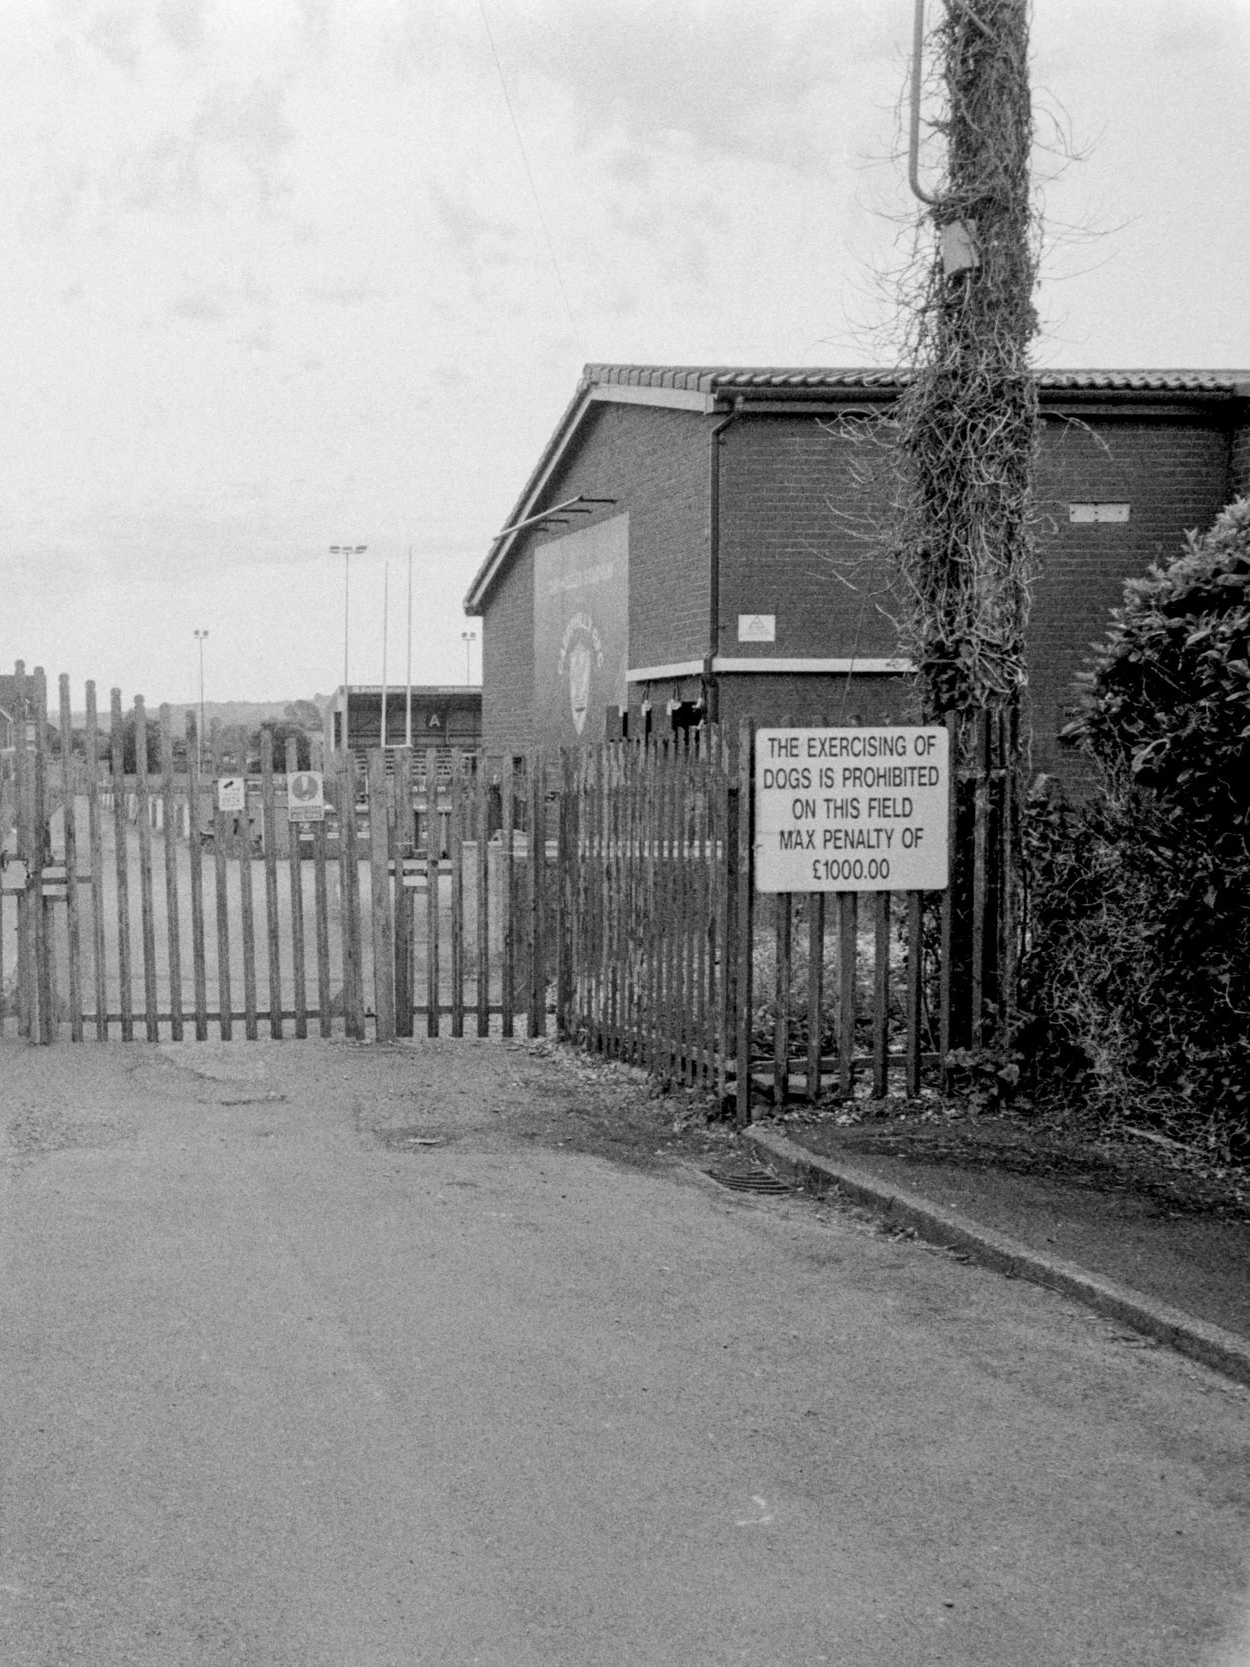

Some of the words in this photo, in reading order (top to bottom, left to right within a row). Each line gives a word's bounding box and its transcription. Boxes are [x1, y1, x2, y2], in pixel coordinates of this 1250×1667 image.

[767, 737, 800, 758] THE
[807, 735, 907, 758] EXERCISING
[914, 735, 937, 757] OF
[763, 767, 812, 790] DOGS
[819, 767, 835, 789] IS
[842, 766, 940, 788] PROHIBITED
[792, 798, 817, 820] ON
[823, 797, 861, 820] THIS
[868, 797, 914, 819] FIELD
[779, 829, 816, 851] MAX
[823, 828, 895, 850] PENALTY
[901, 827, 924, 849] OF
[812, 858, 891, 881] £1000.00
